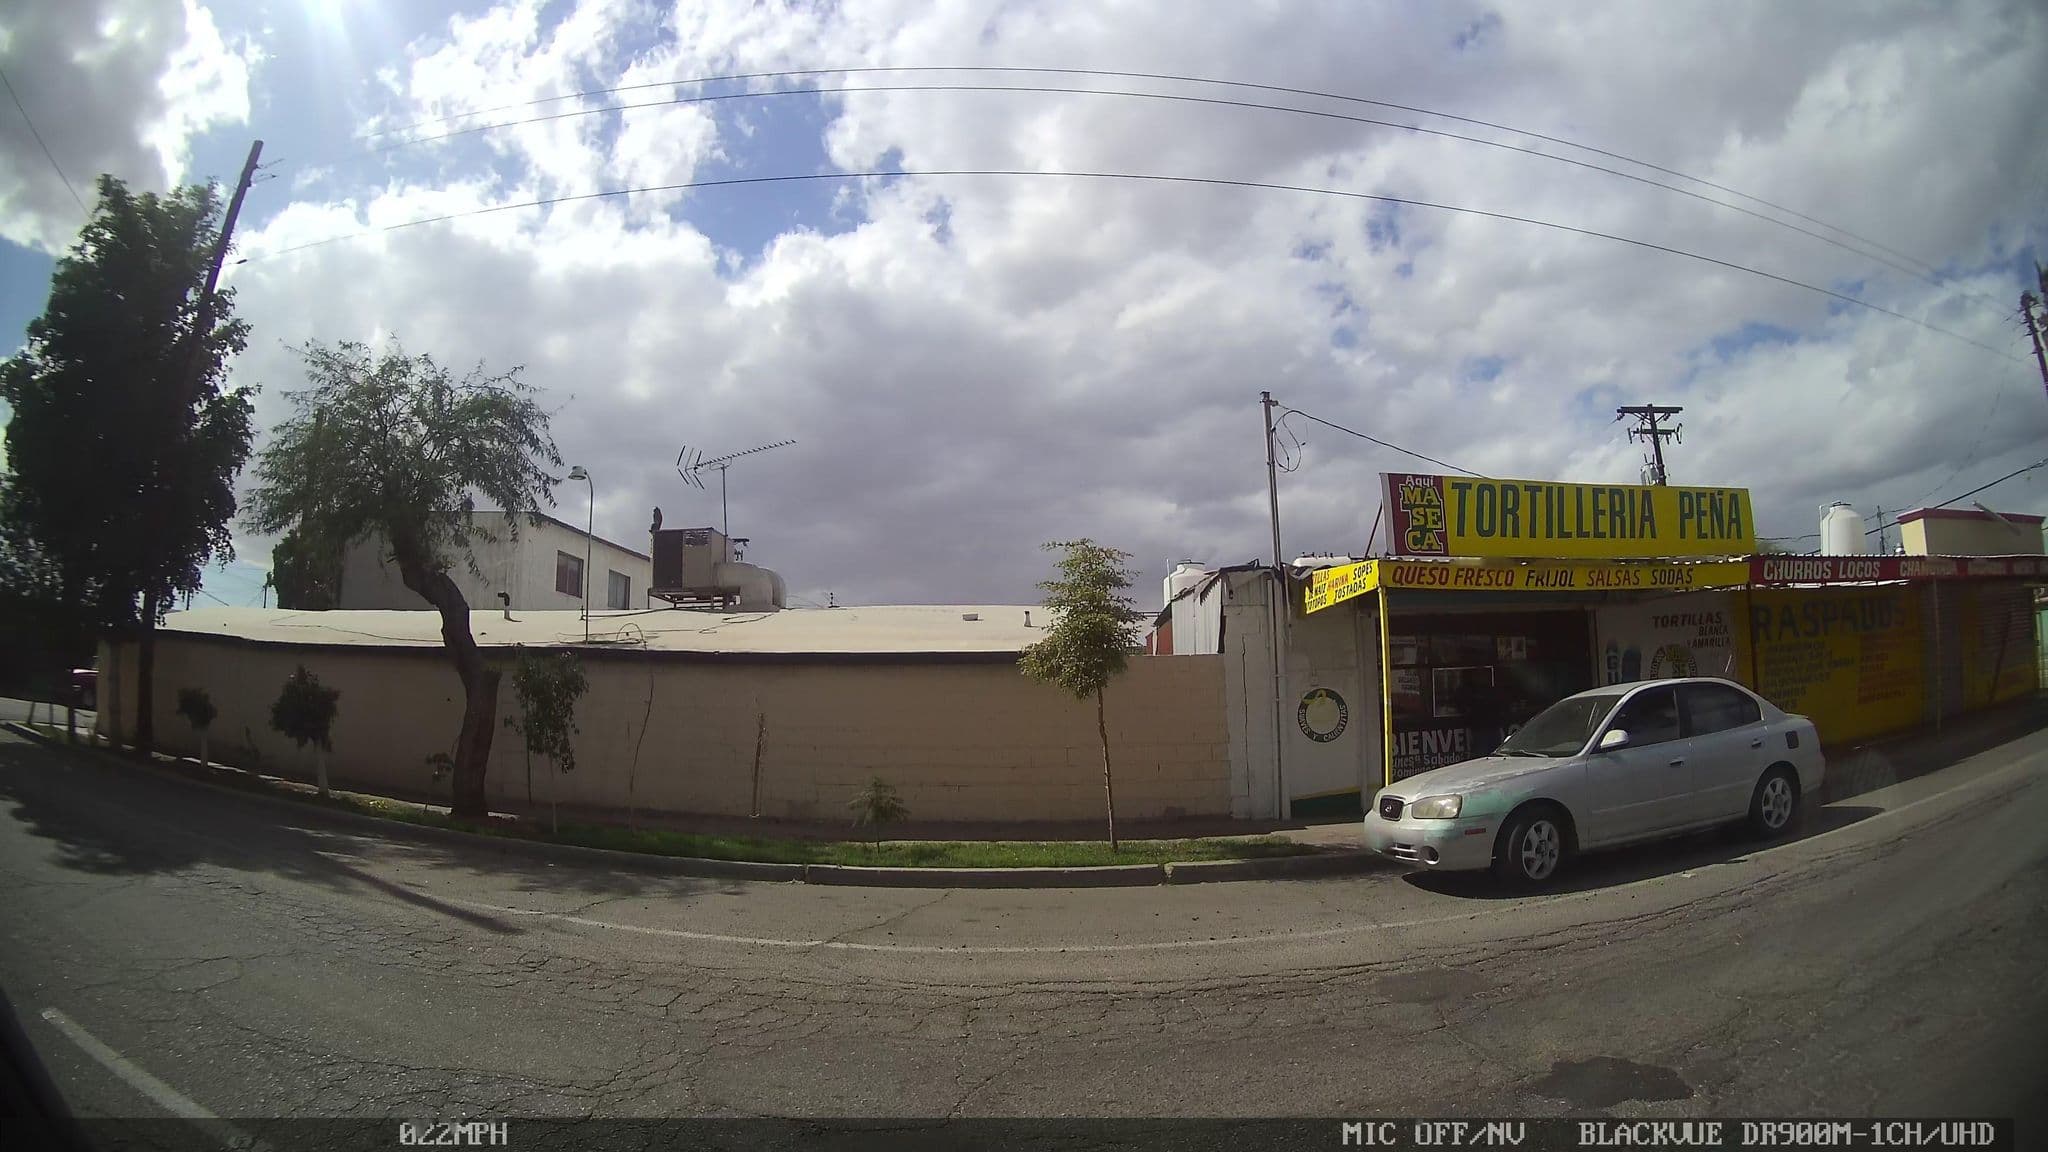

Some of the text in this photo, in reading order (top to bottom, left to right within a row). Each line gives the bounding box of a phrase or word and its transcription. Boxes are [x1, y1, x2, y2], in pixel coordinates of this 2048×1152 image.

[1402, 486, 1440, 505] MA
[1412, 507, 1442, 528] SE
[1451, 482, 1742, 539] TORTILLERIA PEÑA
[1408, 531, 1440, 550] CA
[1353, 562, 1373, 580] SOPES
[1392, 565, 1694, 587] QUESO FRESCO FRIJOL SALSAS SODAS
[1764, 559, 1832, 580] CHURROS
[1838, 560, 1881, 579] LOCOS
[1334, 577, 1366, 602] TOSTADAS
[1651, 612, 1722, 629] TORTILLAS
